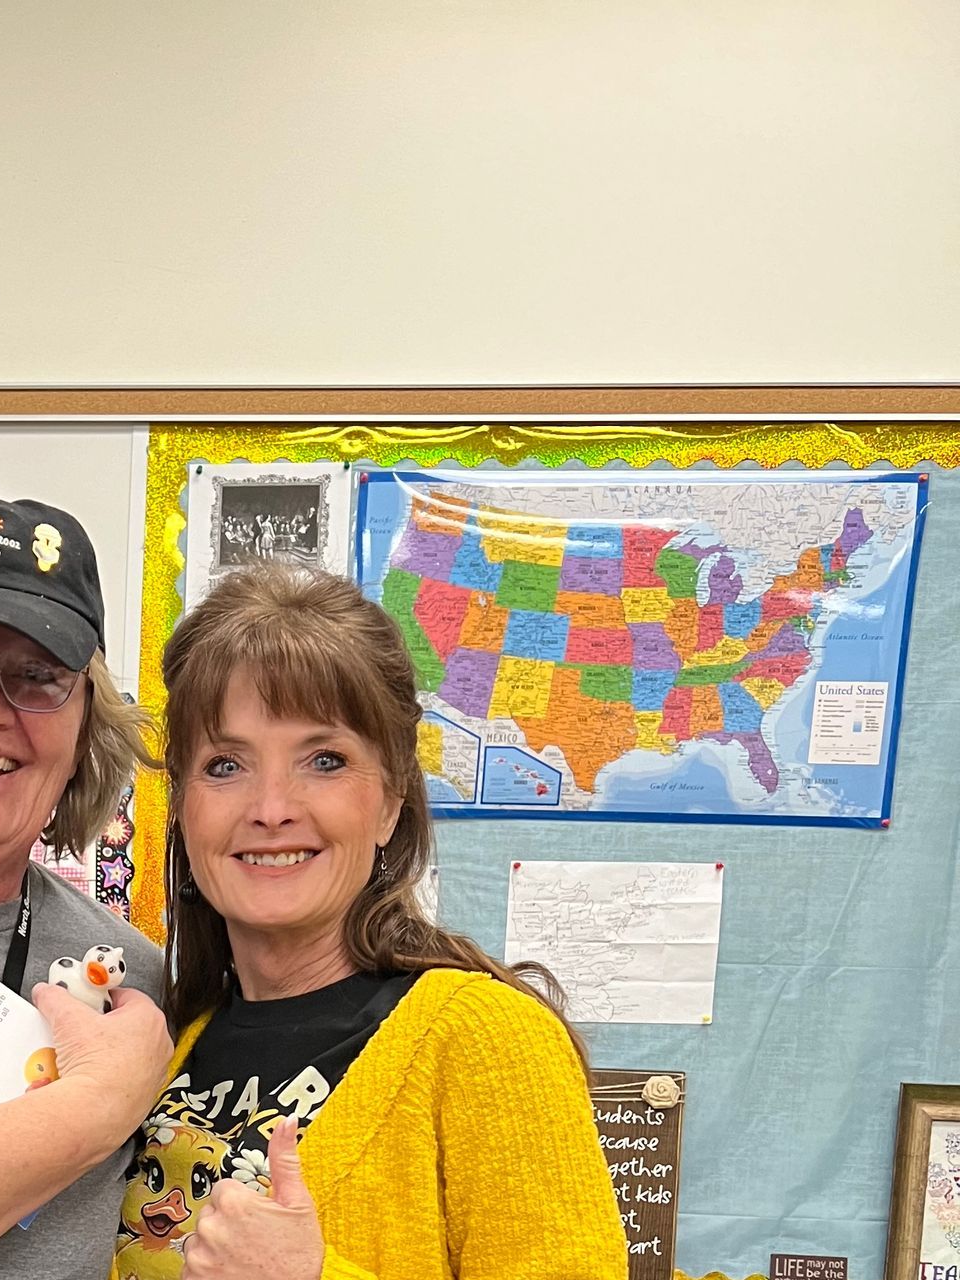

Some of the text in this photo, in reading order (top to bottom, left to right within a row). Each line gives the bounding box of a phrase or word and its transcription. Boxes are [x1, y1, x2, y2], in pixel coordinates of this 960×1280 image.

[861, 632, 884, 641] Ocean
[819, 684, 885, 696] United States
[486, 733, 518, 744] MEXICO
[679, 783, 705, 791] Mexico
[17, 908, 31, 938] North
[591, 1104, 665, 1126] tudents
[598, 1134, 660, 1151] ecause
[607, 1156, 673, 1181] gether
[613, 1182, 673, 1205] st kids
[619, 1209, 641, 1233] st,
[775, 1258, 845, 1277] LIFE may not
[806, 1268, 844, 1279] be the
